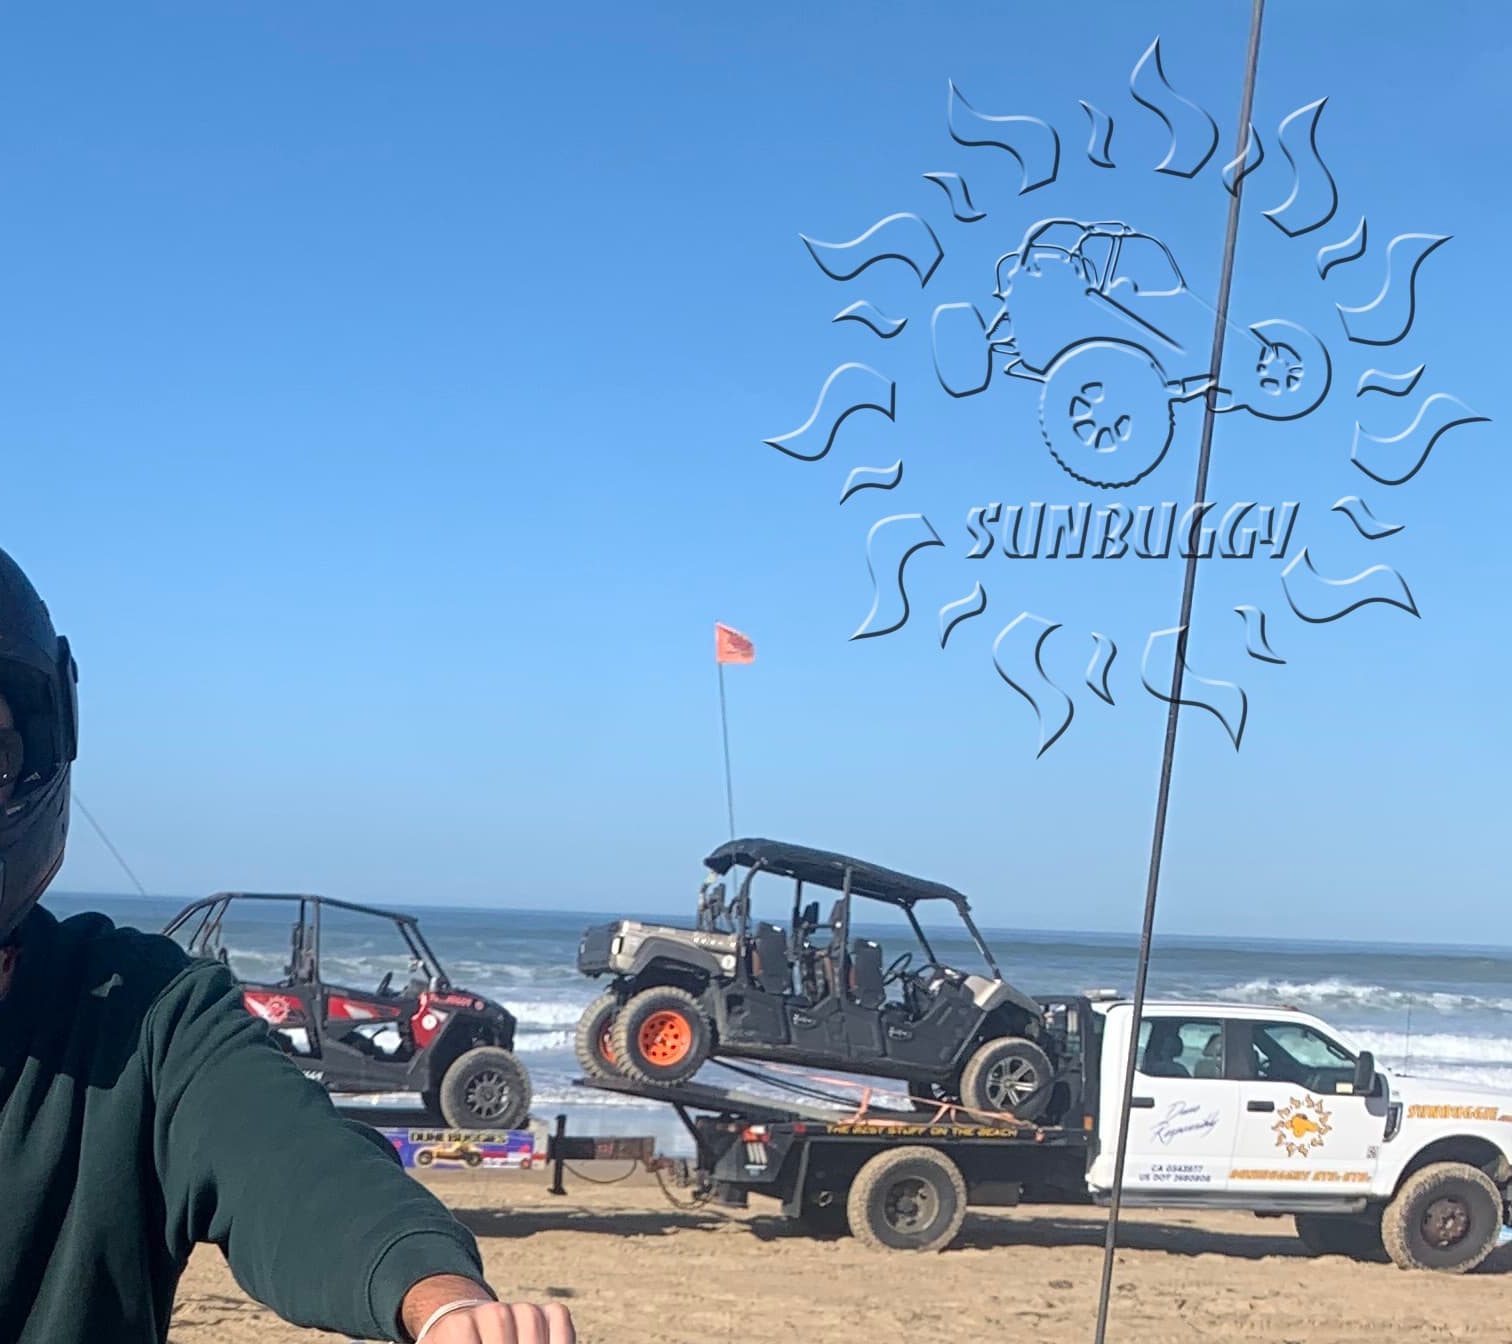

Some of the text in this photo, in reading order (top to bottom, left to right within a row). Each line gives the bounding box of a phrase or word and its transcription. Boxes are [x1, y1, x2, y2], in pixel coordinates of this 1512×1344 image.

[826, 1125, 1019, 1138] THE BEST STUFF ON THE BEACH
[1153, 1173, 1172, 1182] DOT
